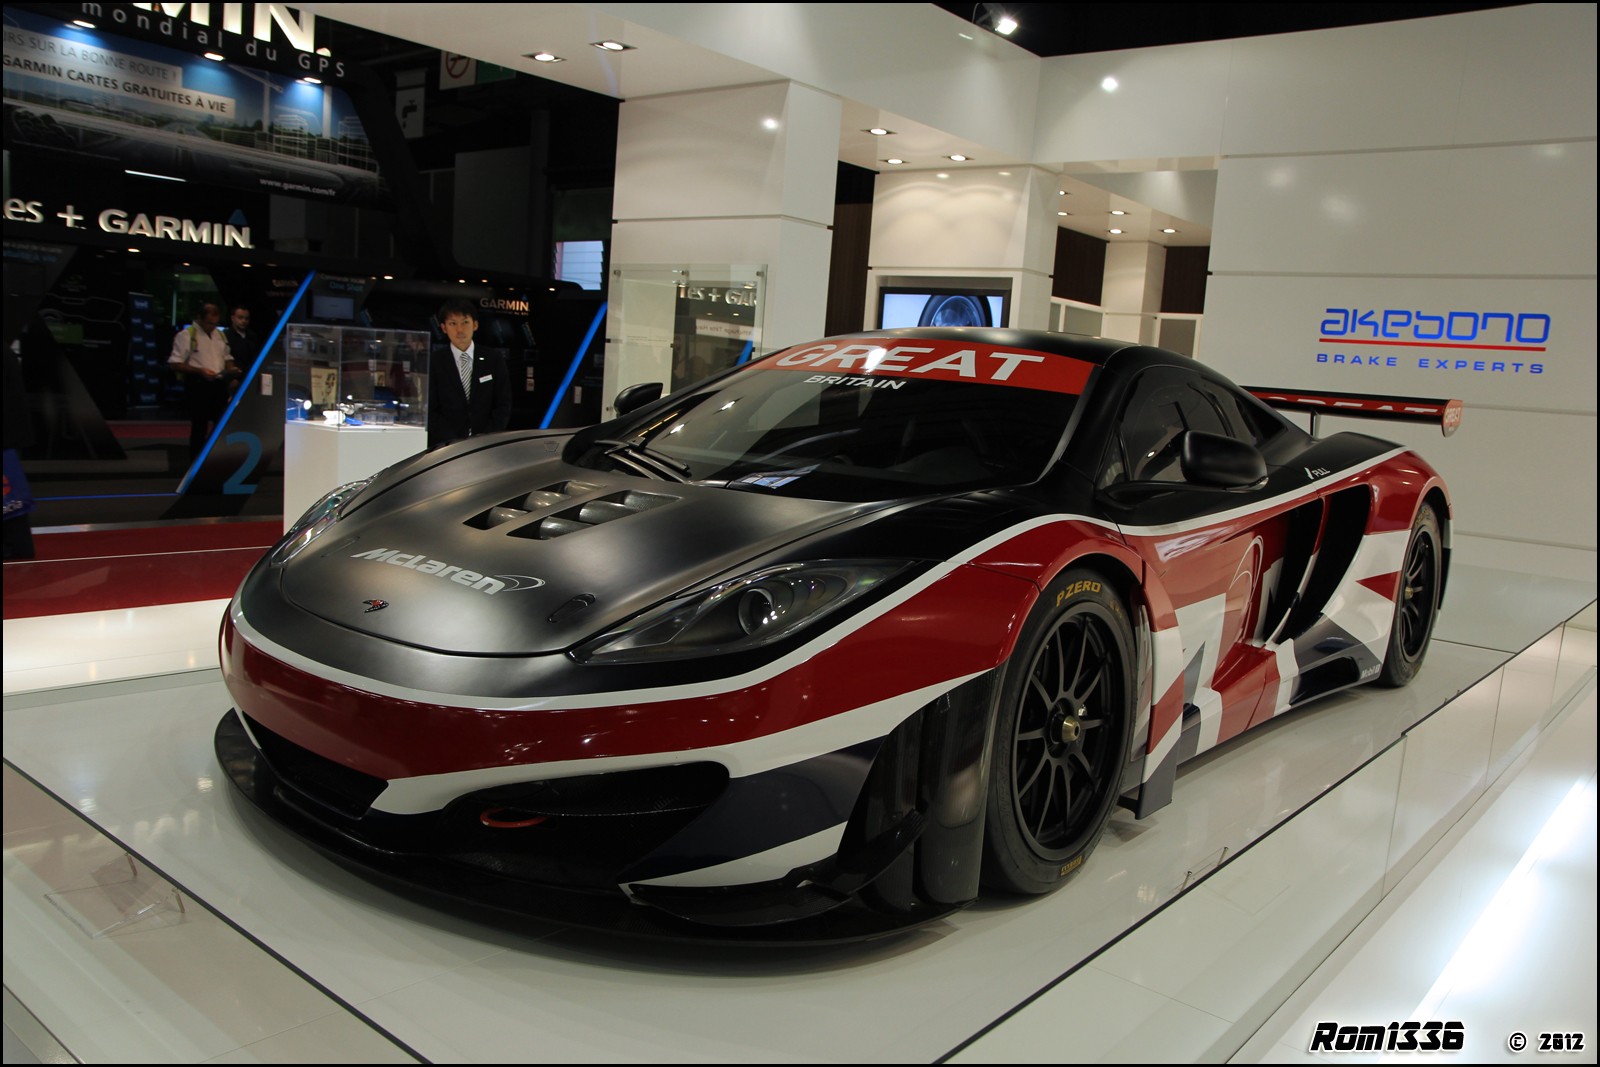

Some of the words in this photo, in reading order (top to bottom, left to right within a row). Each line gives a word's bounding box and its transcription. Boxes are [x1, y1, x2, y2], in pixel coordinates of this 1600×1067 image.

[28, 37, 56, 53] SUR
[60, 45, 77, 59] LA
[81, 50, 126, 70] BONNE
[129, 61, 168, 81] ROUTE
[81, 3, 223, 48] mondial
[245, 38, 278, 62] du
[297, 54, 346, 78] GPS
[3, 55, 62, 78] GARMIN
[67, 69, 118, 91] CARTES
[122, 81, 191, 106] GRATUITES
[195, 94, 205, 108] À
[208, 99, 227, 113] VIE
[3, 197, 44, 223] es
[479, 297, 530, 312] GARMIN
[775, 343, 1045, 381] GREAT
[804, 375, 907, 390] BRITAIN
[1316, 353, 1398, 367] BRAKE
[1418, 358, 1545, 374] EXPERTS
[223, 431, 260, 495] 2
[349, 547, 506, 596] McLaren
